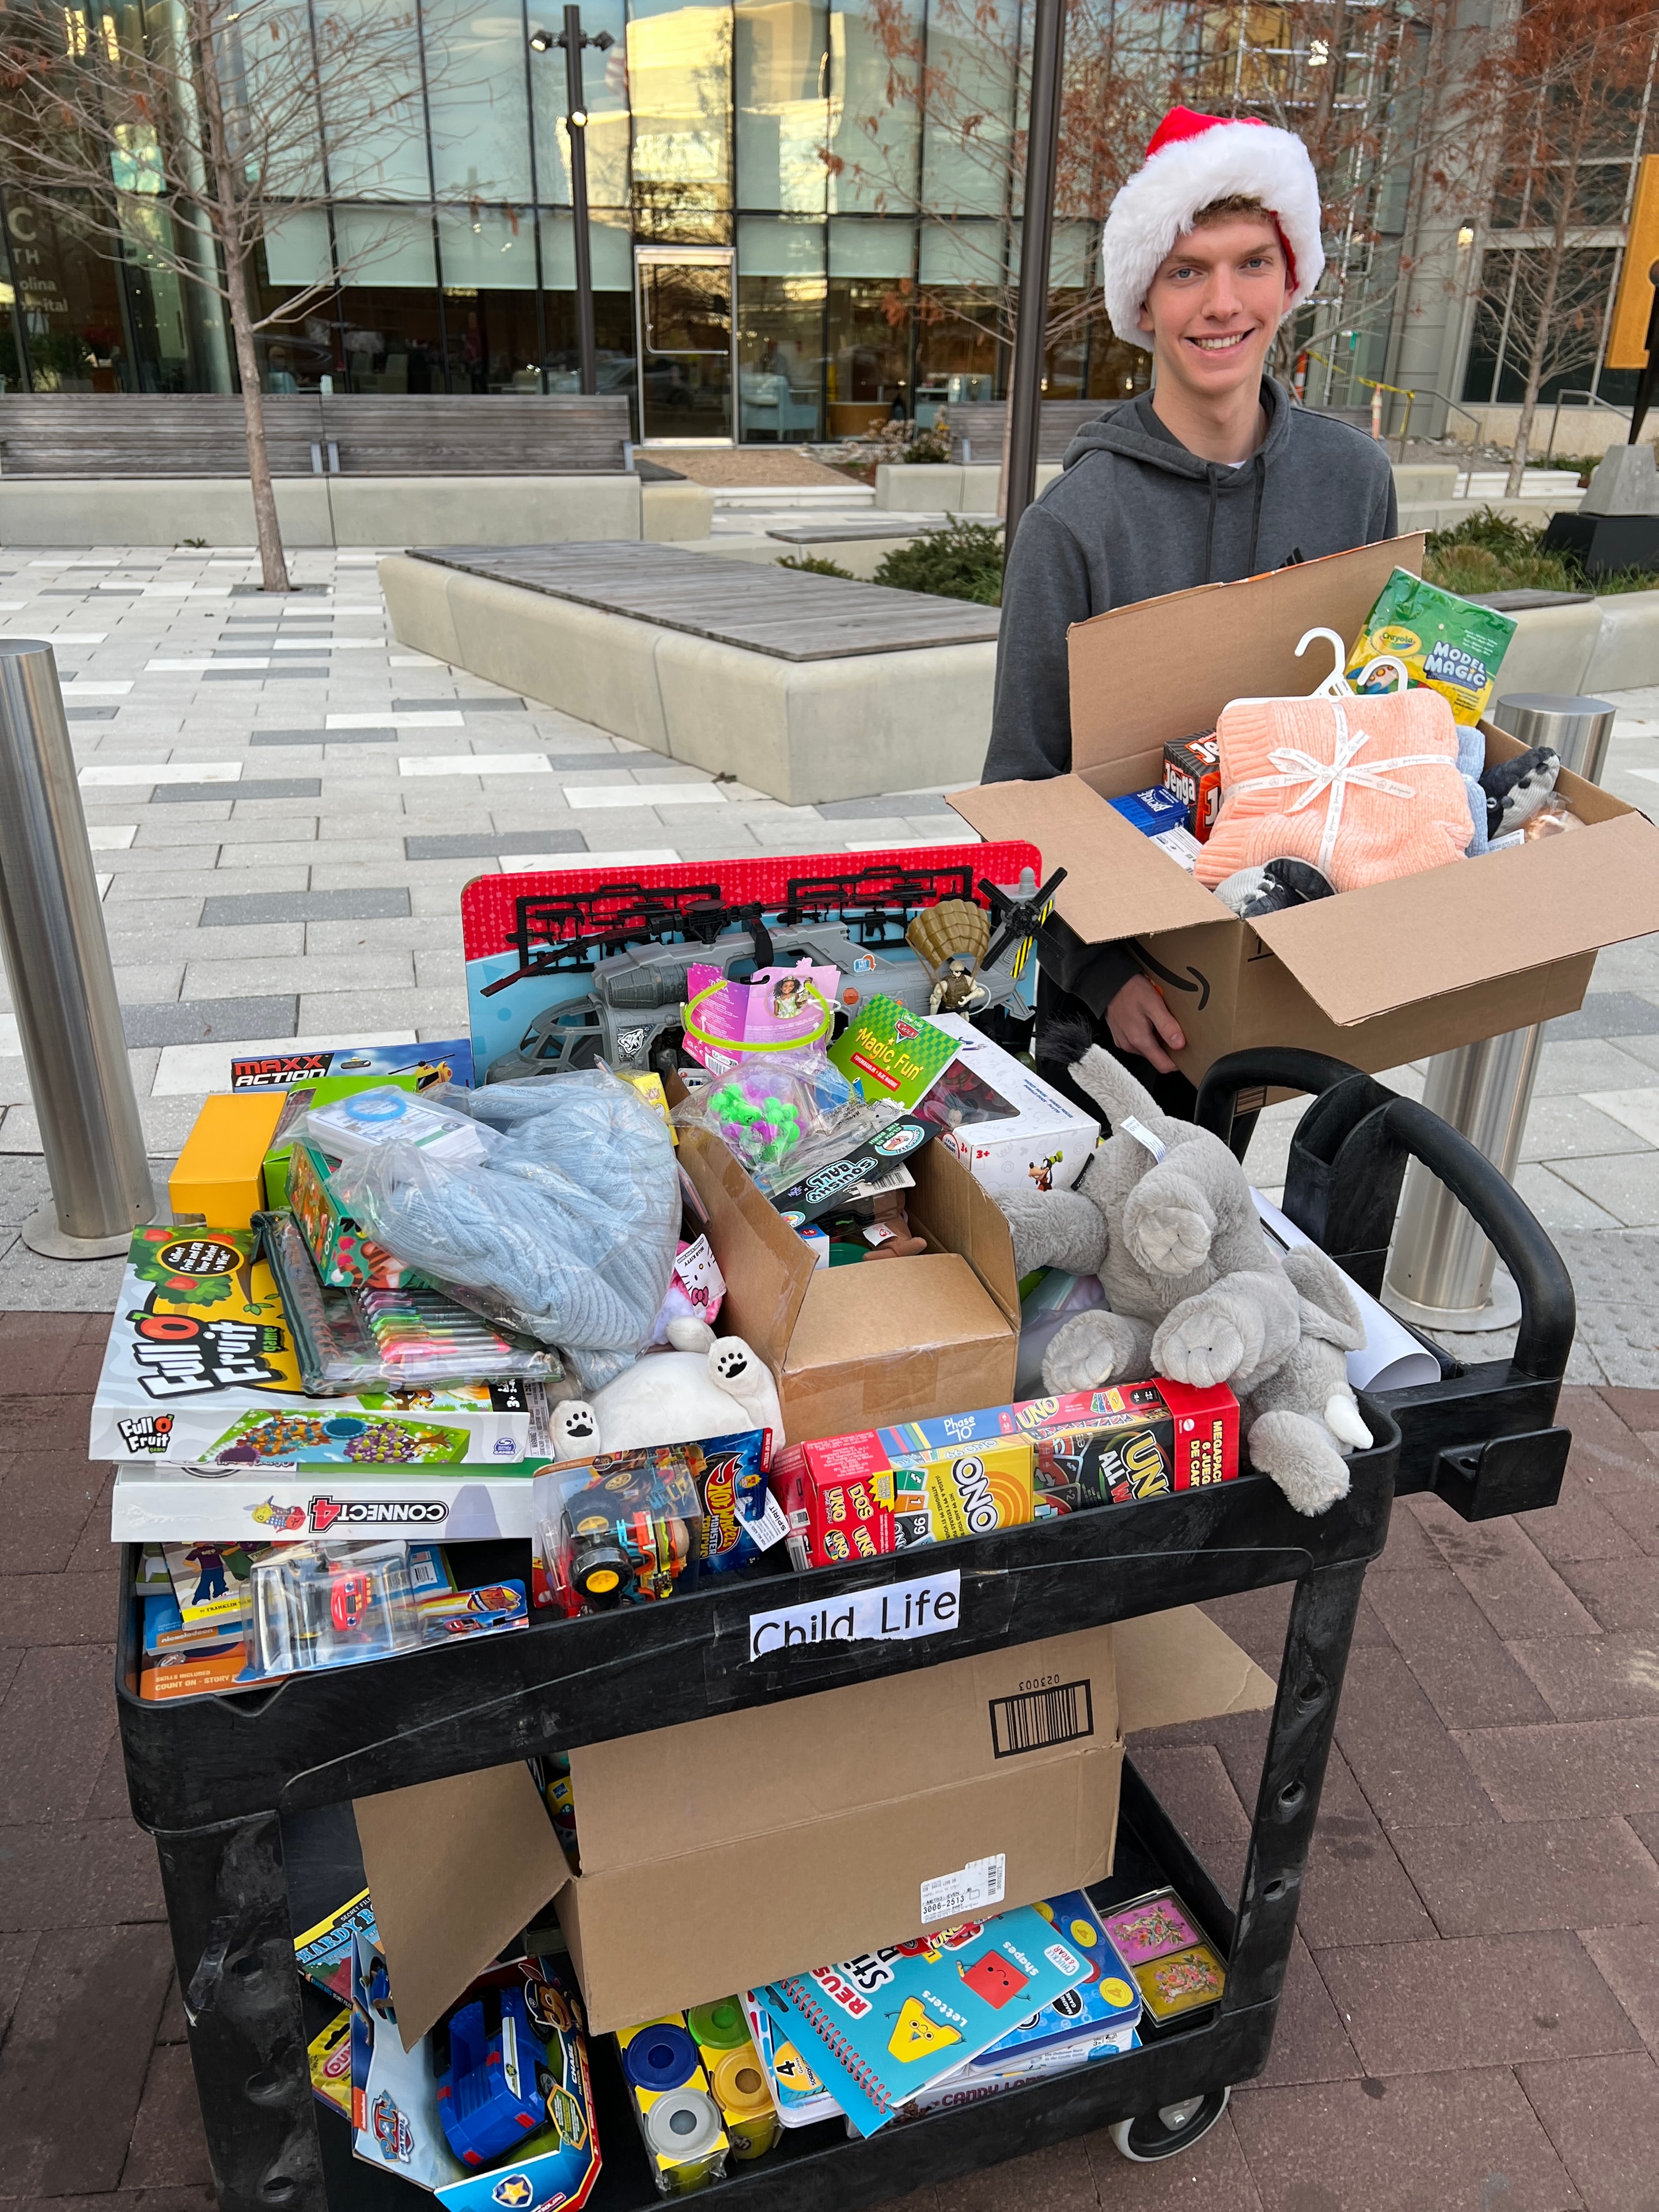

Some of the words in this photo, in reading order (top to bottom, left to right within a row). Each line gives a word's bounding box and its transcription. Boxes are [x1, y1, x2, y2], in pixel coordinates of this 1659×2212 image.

[1382, 632, 1414, 643] Crayola
[1434, 641, 1484, 673] MODEL
[1425, 654, 1486, 688] MAGIC
[1165, 762, 1195, 805] Jenga
[897, 1023, 915, 1037] Cars
[855, 1027, 895, 1063] Magic
[893, 1053, 920, 1081] Fun
[234, 1055, 323, 1075] MAXX
[235, 1068, 326, 1086] ACTION
[976, 1149, 990, 1159] 3+
[812, 1163, 851, 1186] BALL
[812, 1160, 873, 1200] SQUISHY
[168, 1247, 185, 1262] Collect
[189, 1250, 200, 1259] and
[191, 1242, 204, 1251] Fill
[201, 1245, 219, 1261] Basket
[695, 1246, 704, 1257] HELLO
[180, 1259, 195, 1271] Fruit
[195, 1261, 210, 1271] Your
[684, 1255, 696, 1267] KITTY
[263, 1327, 282, 1352] game
[203, 1321, 272, 1382] Fruit
[142, 1344, 214, 1395] Full
[506, 1396, 520, 1408] 3+
[1015, 1396, 1059, 1430] UNO
[120, 1416, 153, 1437] Full
[944, 1415, 975, 1433] Phase
[946, 1423, 976, 1442] 10
[128, 1433, 170, 1452] Fruit
[963, 1440, 998, 1453] ONO
[1190, 1440, 1200, 1459] DE
[1203, 1442, 1211, 1450] 6
[1098, 1450, 1122, 1486] ALL
[829, 1486, 846, 1522] UNO
[847, 1483, 874, 1520] DOS
[953, 1456, 998, 1533] ONO
[1066, 1489, 1075, 1501] +2
[313, 1499, 340, 1529] 4
[336, 1504, 444, 1521] CONNECT
[769, 1506, 786, 1531] SPIRIT
[931, 1486, 942, 1512] ATTEIGNEZ
[942, 1525, 950, 1539] VOUS
[709, 1515, 719, 1555] MONSTER
[914, 1517, 926, 1535] 99
[824, 1536, 833, 1546] ALL
[832, 1531, 850, 1558] UNO
[852, 1525, 877, 1557] UNO
[206, 1602, 237, 1612] FRANKLIN
[753, 1607, 854, 1656] Child
[881, 1589, 957, 1634] Life
[161, 1628, 213, 1643] nickelodeon
[155, 1681, 183, 1691] COUNT
[204, 1675, 230, 1684] STORY
[156, 1675, 178, 1683] SKILLS
[180, 1670, 211, 1679] INCLUDED
[1019, 1674, 1060, 1691] 023003
[340, 1906, 359, 1922] SECRET
[923, 1895, 964, 1914] 3006-2513
[296, 1916, 363, 1963] HARDY
[931, 1924, 963, 1949] UNO
[1002, 1941, 1039, 1976] shapes
[1046, 1949, 1075, 1974] CHUCKLE
[1052, 1945, 1071, 1960] ROAR
[843, 1953, 889, 1989] Sti
[922, 1990, 968, 2027] Letters
[568, 2043, 578, 2084] CHASE
[777, 2061, 795, 2077] 4
[796, 2057, 804, 2074] Games
[942, 2083, 1001, 2107] CANDY
[378, 2090, 399, 2160] PAW
